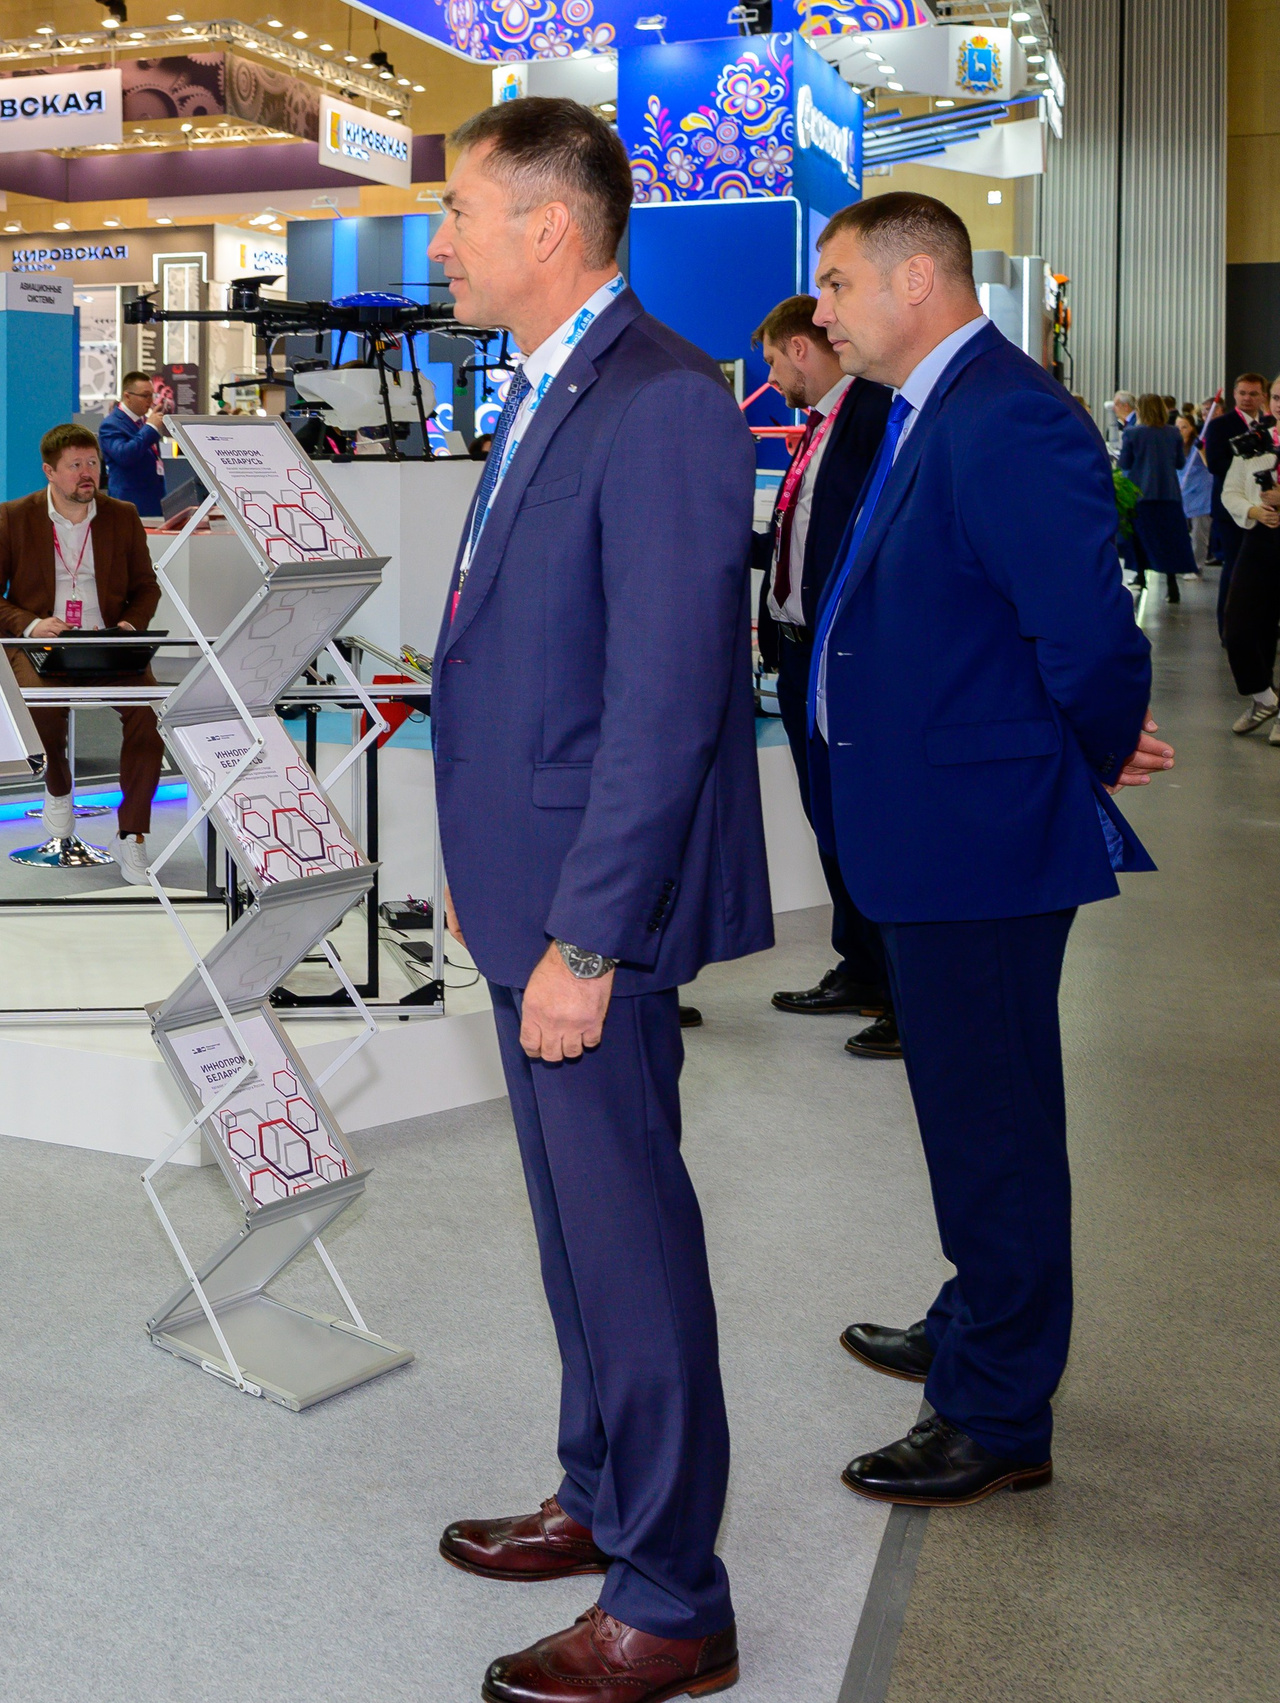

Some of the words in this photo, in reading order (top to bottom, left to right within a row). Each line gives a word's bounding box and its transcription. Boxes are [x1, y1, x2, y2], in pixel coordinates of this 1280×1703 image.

[12, 245, 128, 264] КИРОВСКАЯ
[20, 282, 62, 294] АВИАЦИОННЫЕ
[27, 294, 55, 304] СИСТЕМЫ
